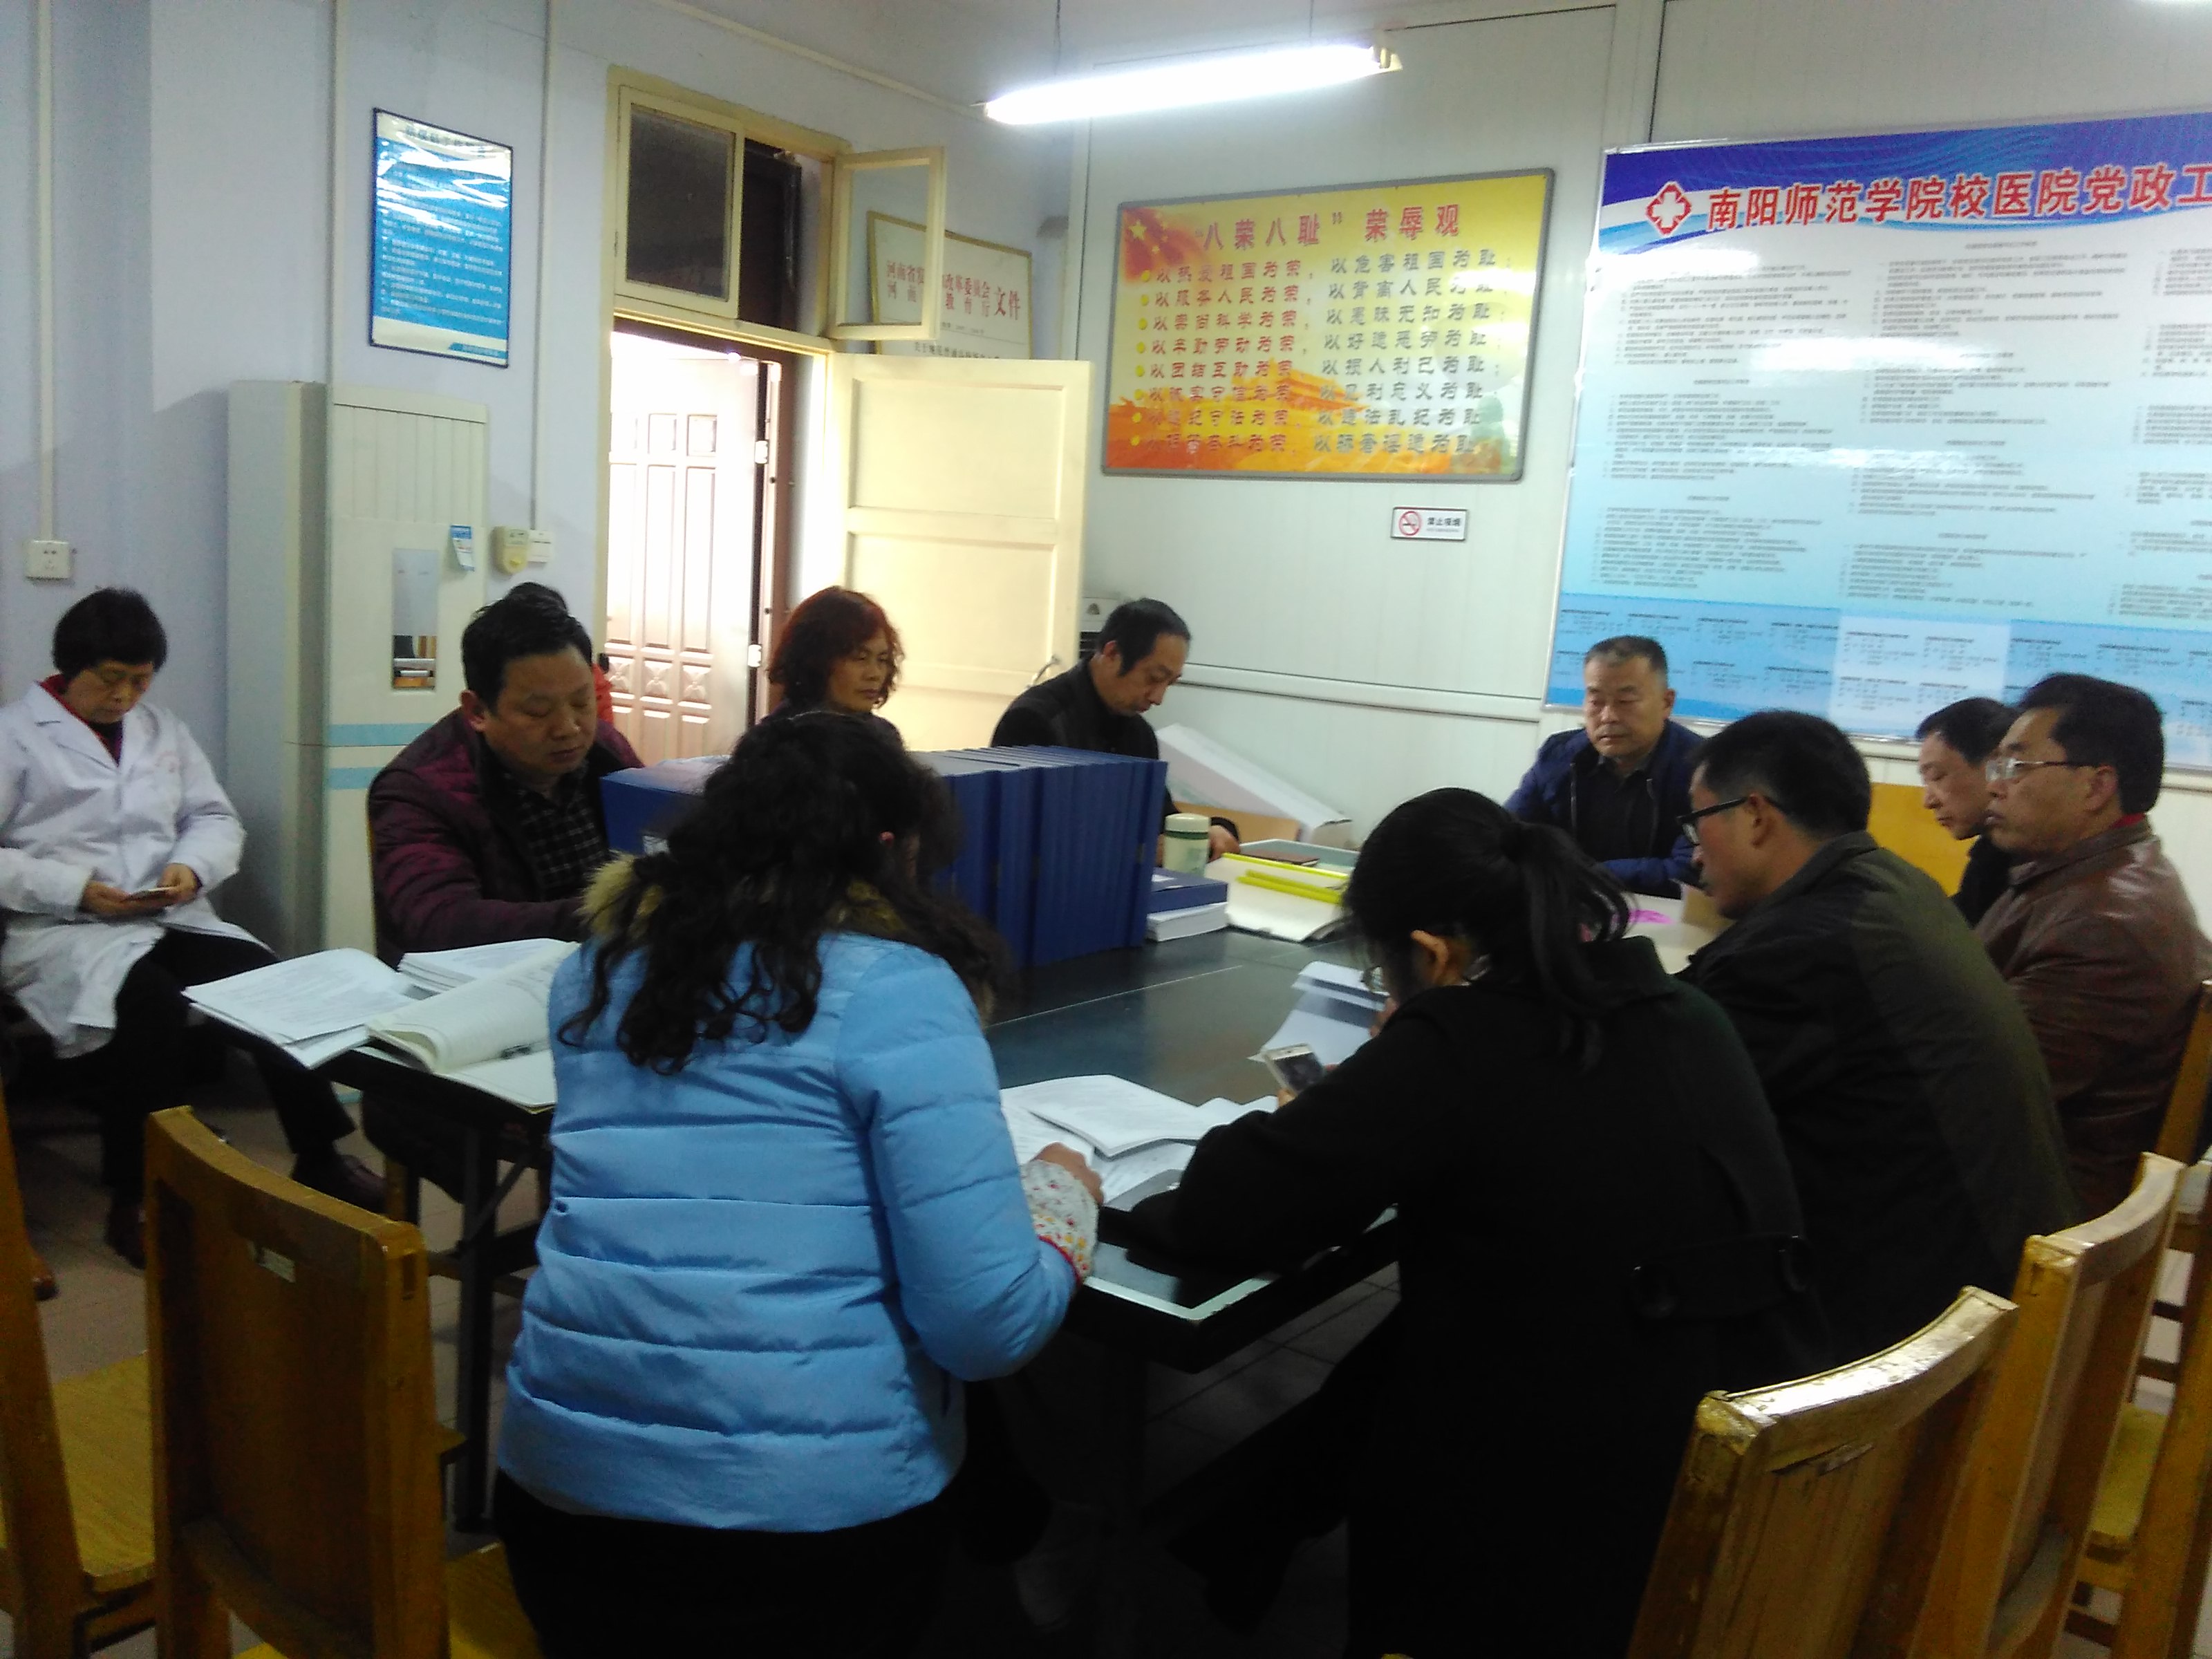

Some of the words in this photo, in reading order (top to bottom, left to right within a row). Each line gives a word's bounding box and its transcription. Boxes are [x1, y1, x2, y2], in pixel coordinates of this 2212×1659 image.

[1706, 163, 2212, 229] 南阳师范学院校医院党政工
